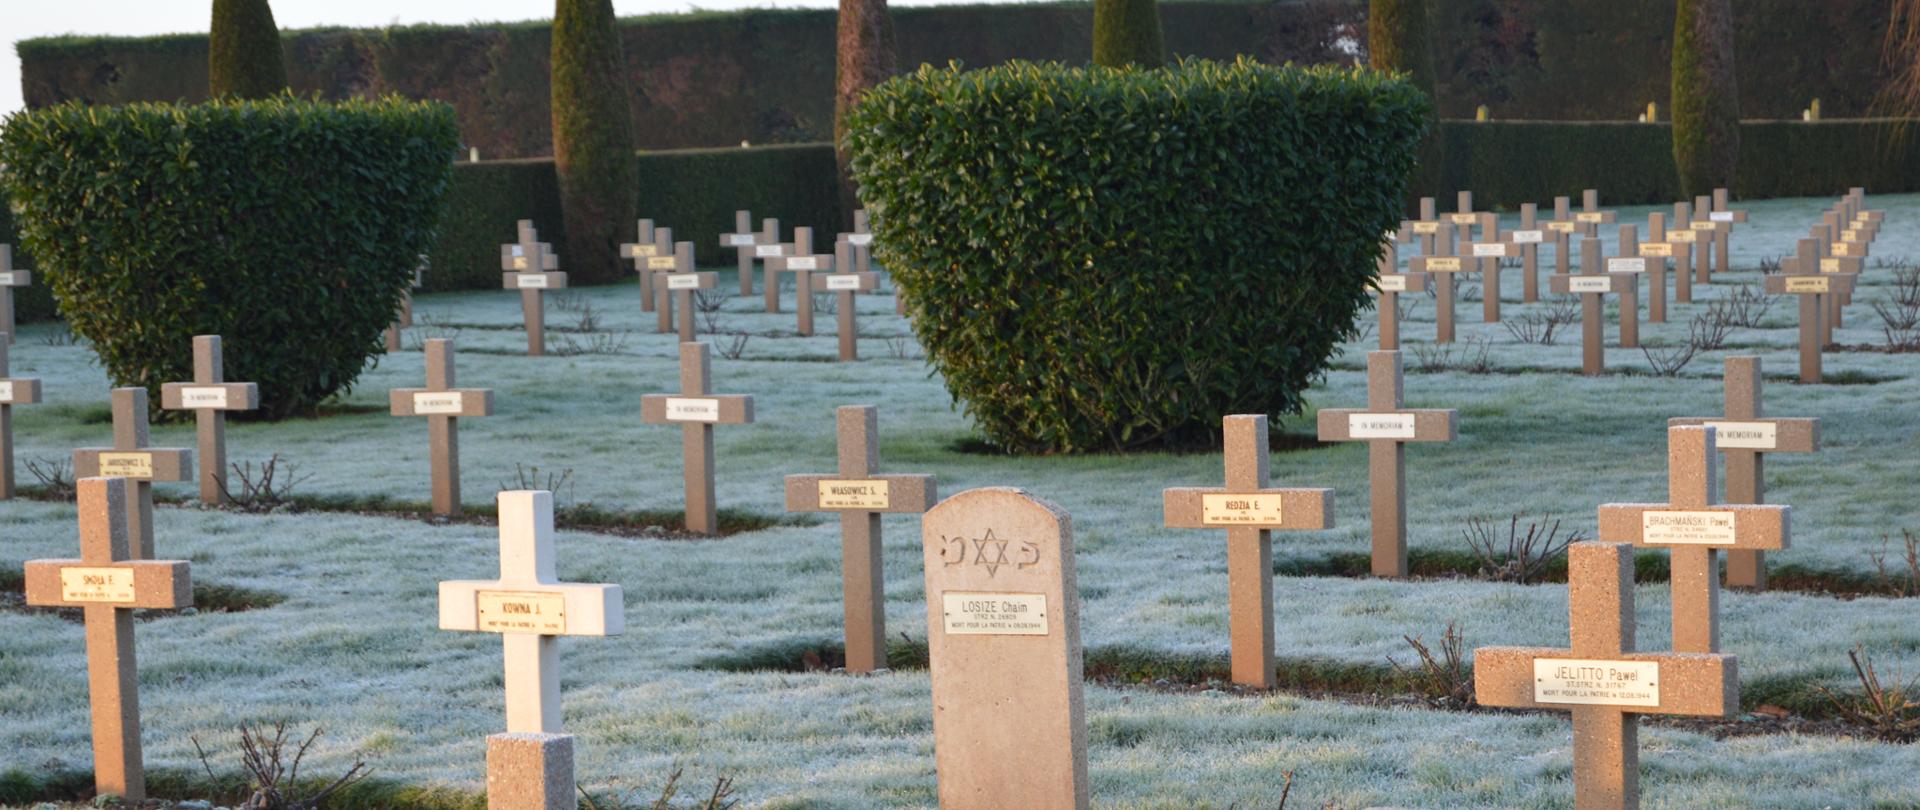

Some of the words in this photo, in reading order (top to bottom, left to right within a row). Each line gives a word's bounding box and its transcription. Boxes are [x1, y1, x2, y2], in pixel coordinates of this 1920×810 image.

[1370, 421, 1403, 430] MEMORIAM
[1716, 431, 1724, 439] IN
[1727, 431, 1763, 439] MEMORIAM
[502, 602, 532, 615] KOWNA
[961, 601, 998, 613] LOSIZE
[1001, 601, 1028, 614] Chaim
[1554, 666, 1604, 680] JELITTO
[1543, 689, 1559, 697] MORT
[1562, 689, 1578, 697] POUR
[1590, 690, 1609, 698] PATRIE
